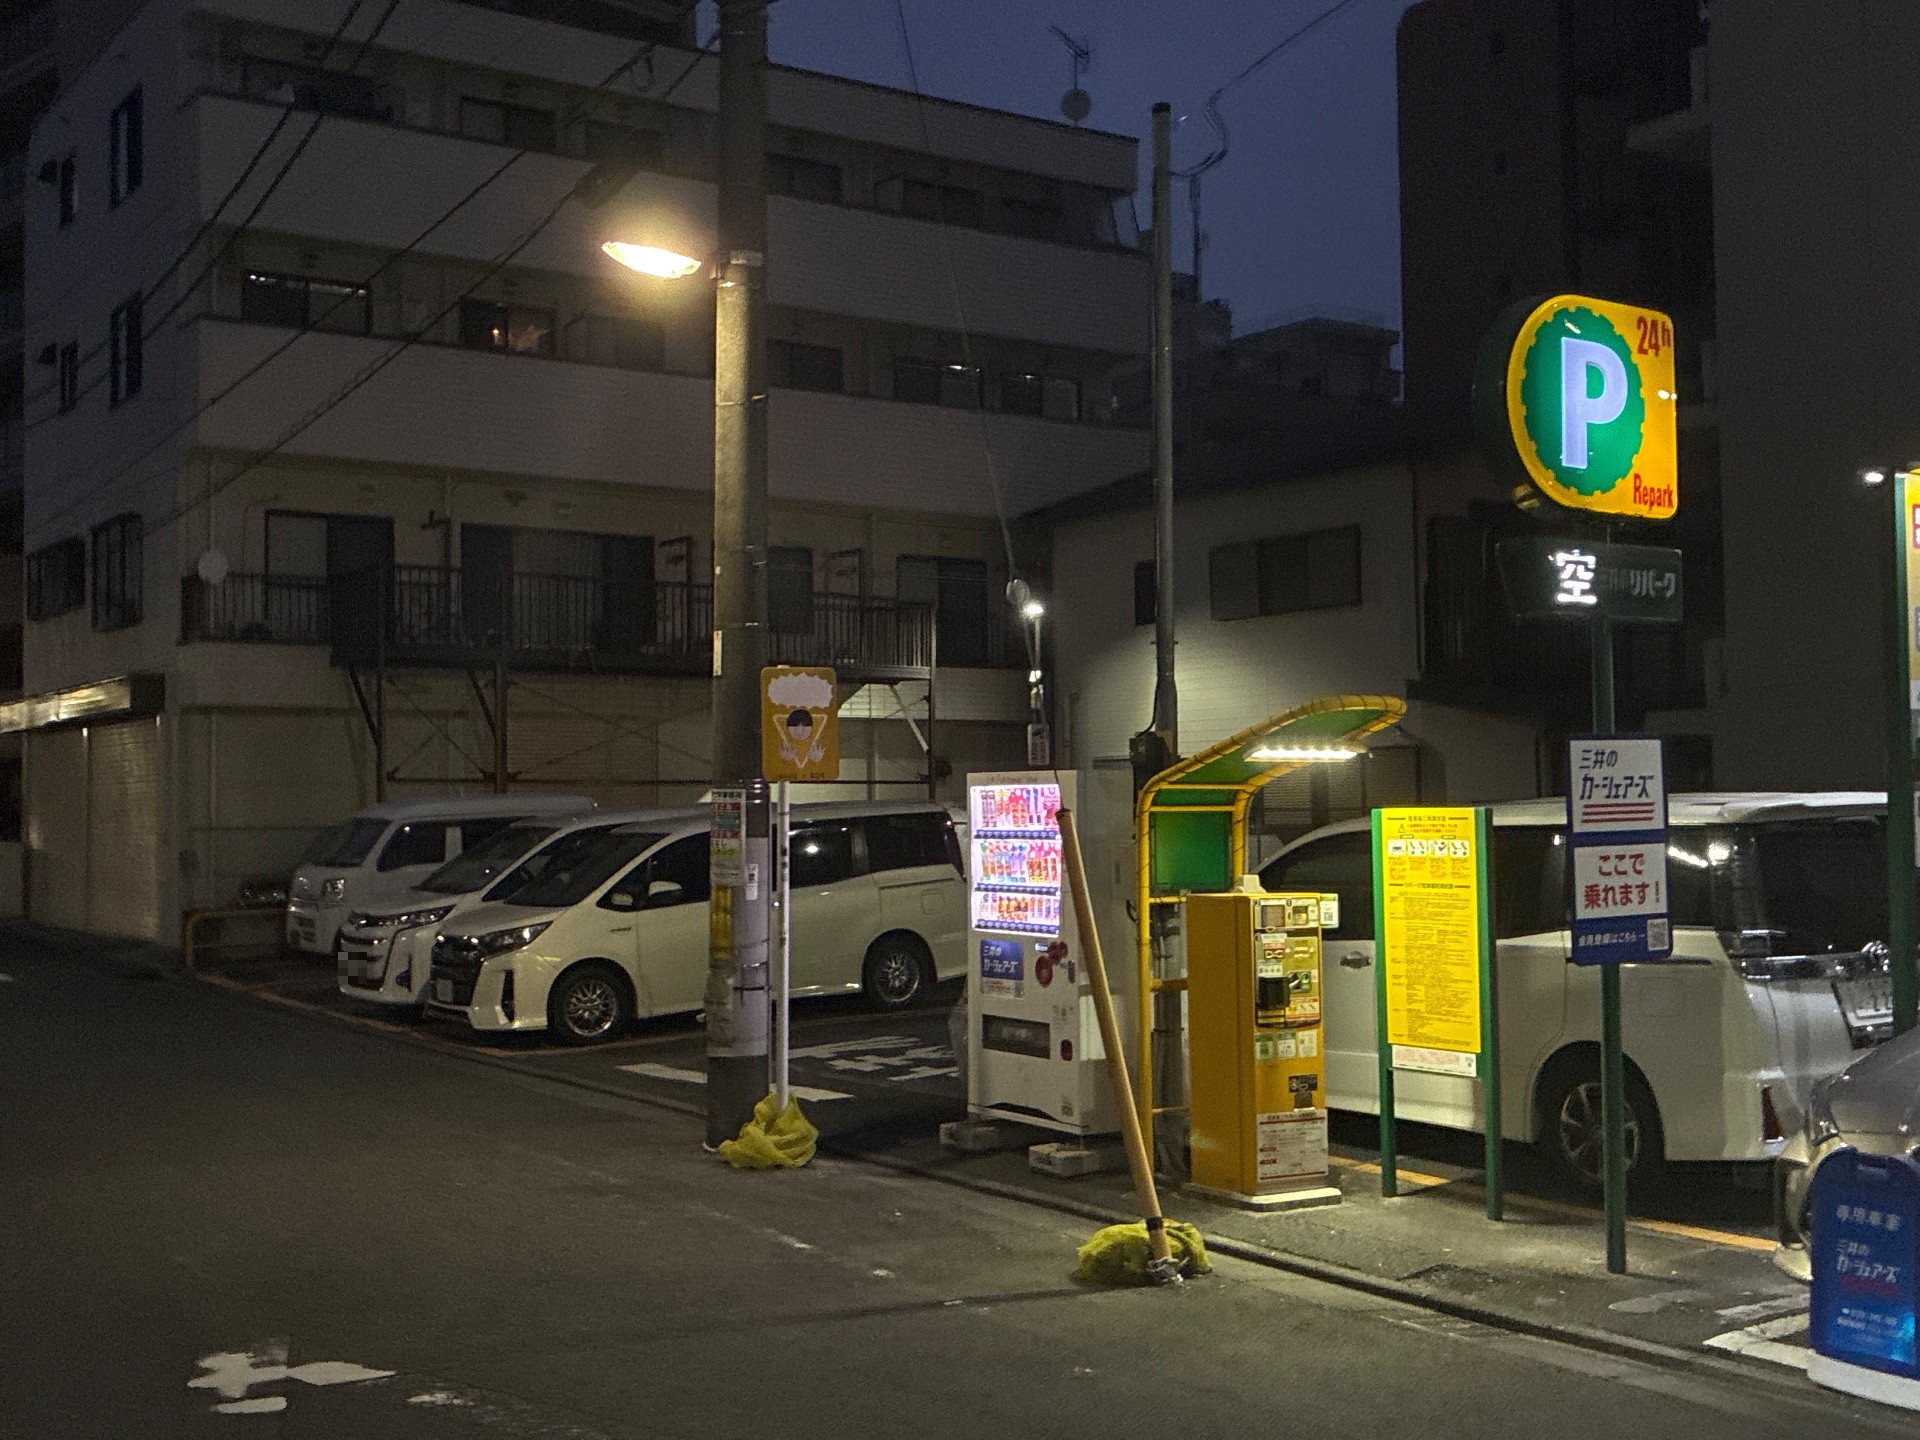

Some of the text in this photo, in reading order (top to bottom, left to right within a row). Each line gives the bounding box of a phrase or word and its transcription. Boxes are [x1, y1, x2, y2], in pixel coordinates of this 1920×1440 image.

[1636, 316, 1672, 357] 24h
[1560, 337, 1628, 469] P
[1633, 473, 1674, 511] Repark
[1556, 549, 1597, 604] 空
[1579, 748, 1618, 770] 三井の
[1579, 774, 1655, 800] カーシェアーズ
[1598, 853, 1645, 877] ここで
[1583, 881, 1661, 910] 乗れます！
